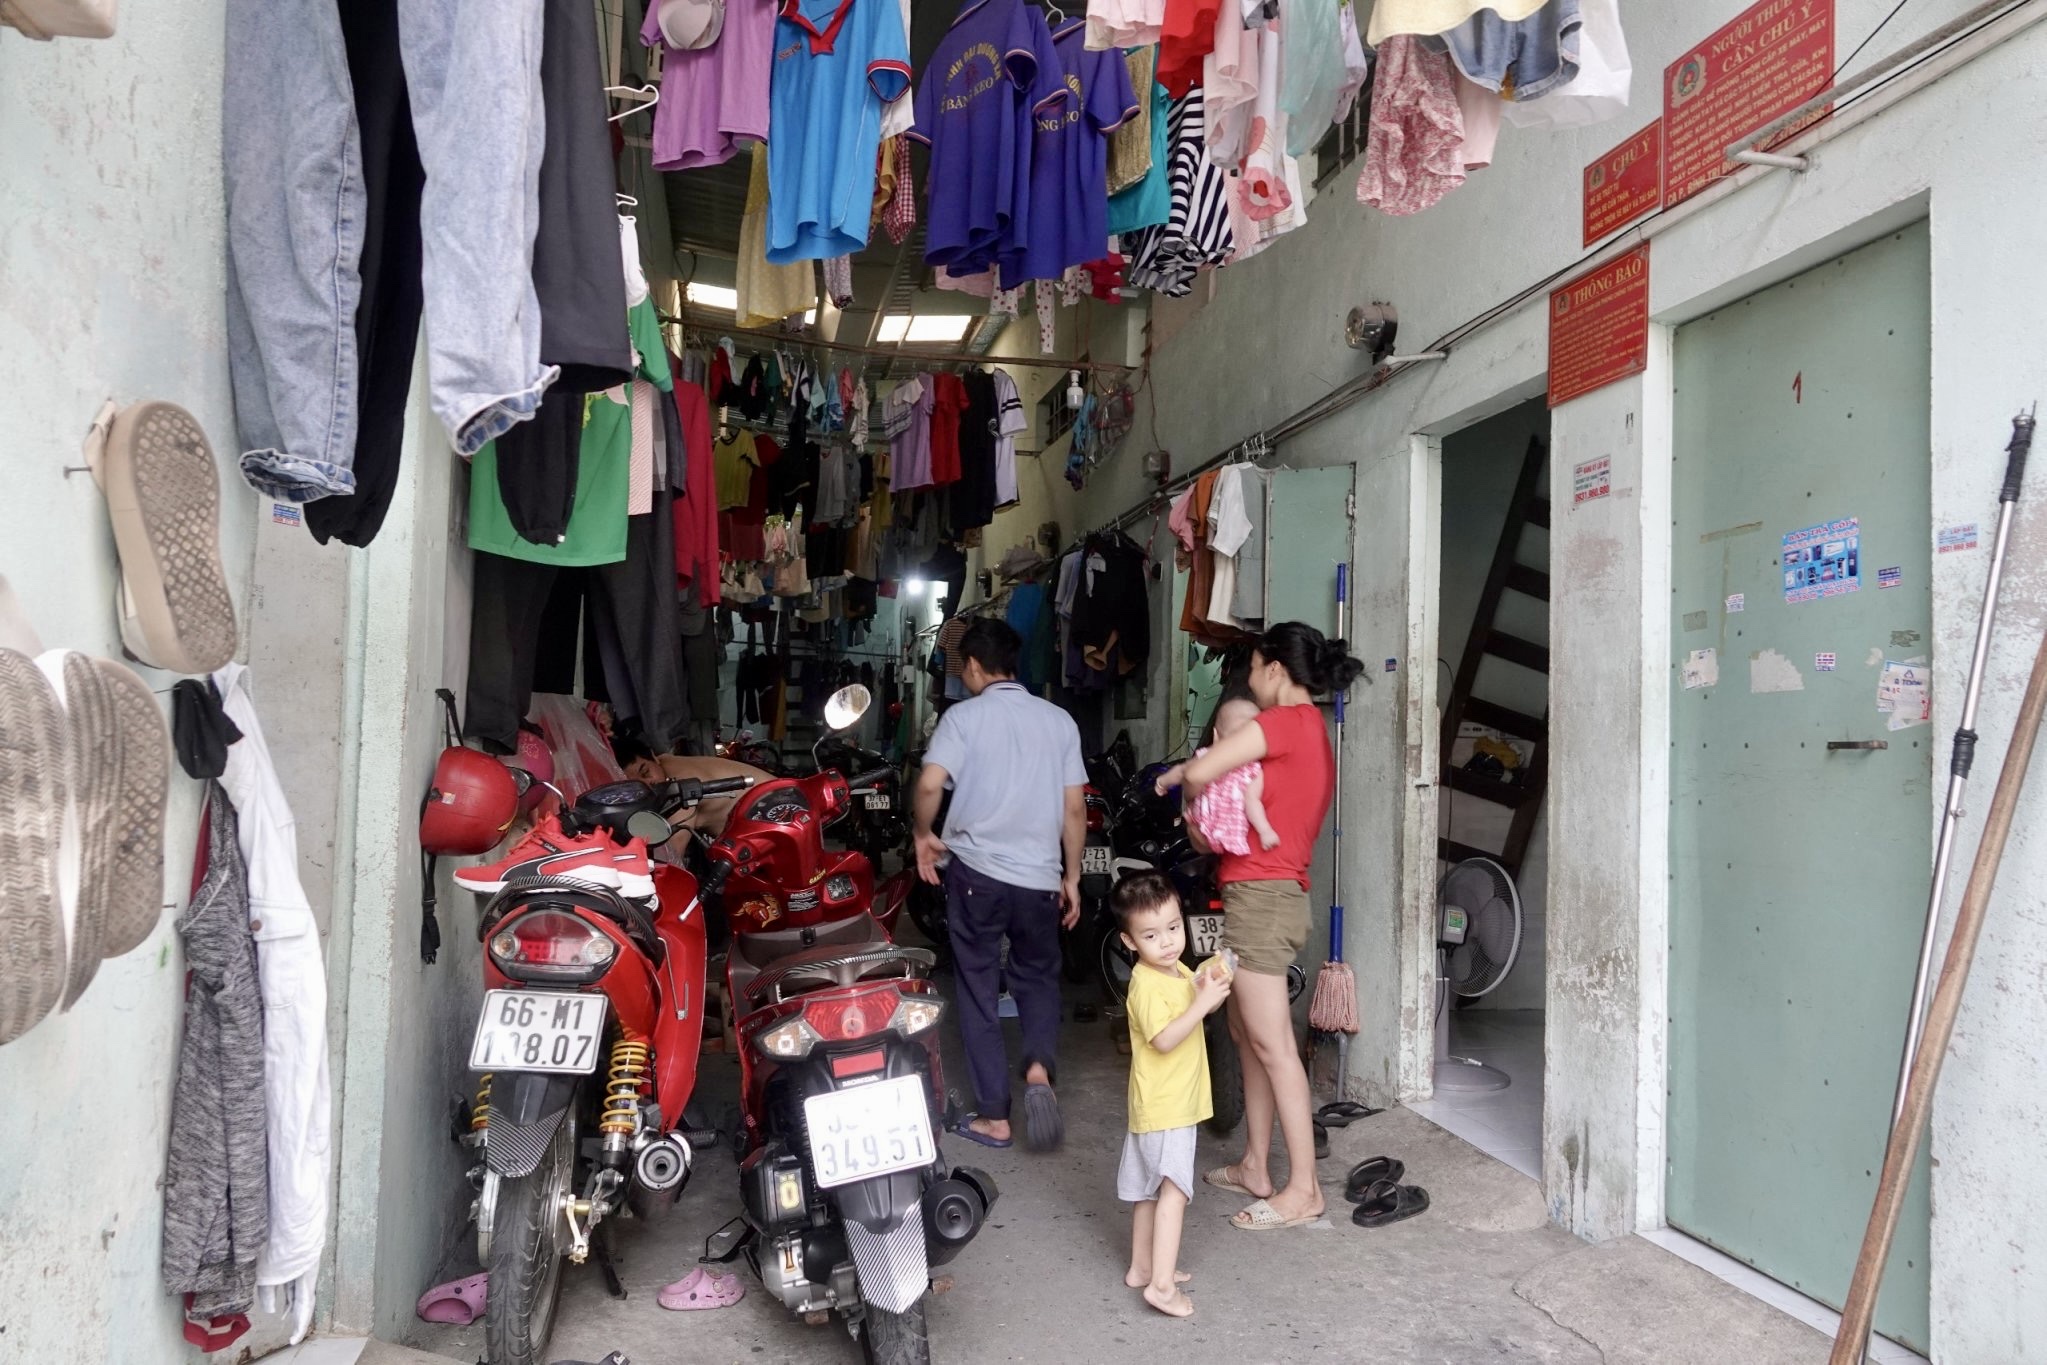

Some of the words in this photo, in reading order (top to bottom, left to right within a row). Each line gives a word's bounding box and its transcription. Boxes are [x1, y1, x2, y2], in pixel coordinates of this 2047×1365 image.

[1711, 20, 1752, 58] NGƯỜI
[1722, 42, 1754, 73] CẦN
[1760, 10, 1795, 47] CHÚ
[1573, 273, 1612, 305] THÔNG
[1616, 258, 1641, 284] BÁO
[1792, 369, 1802, 404] 1
[1197, 935, 1224, 953] 12
[499, 996, 584, 1030] 66-M1
